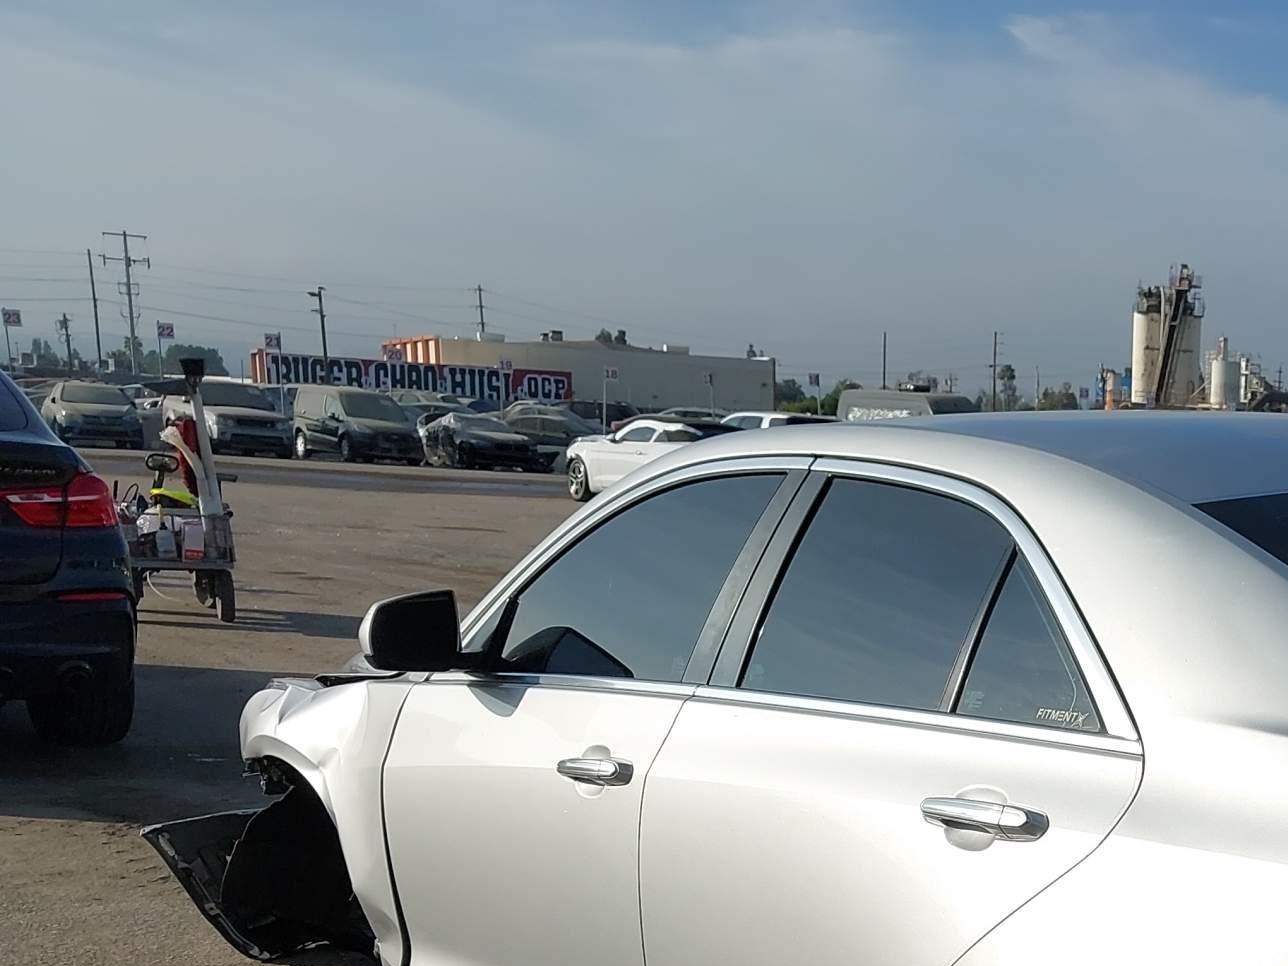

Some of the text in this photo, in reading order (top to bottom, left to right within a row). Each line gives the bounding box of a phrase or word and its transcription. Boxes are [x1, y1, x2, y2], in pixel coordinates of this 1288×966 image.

[5, 312, 21, 324] 23
[158, 326, 174, 337] 22
[265, 336, 280, 348] 21
[388, 350, 402, 360] 20
